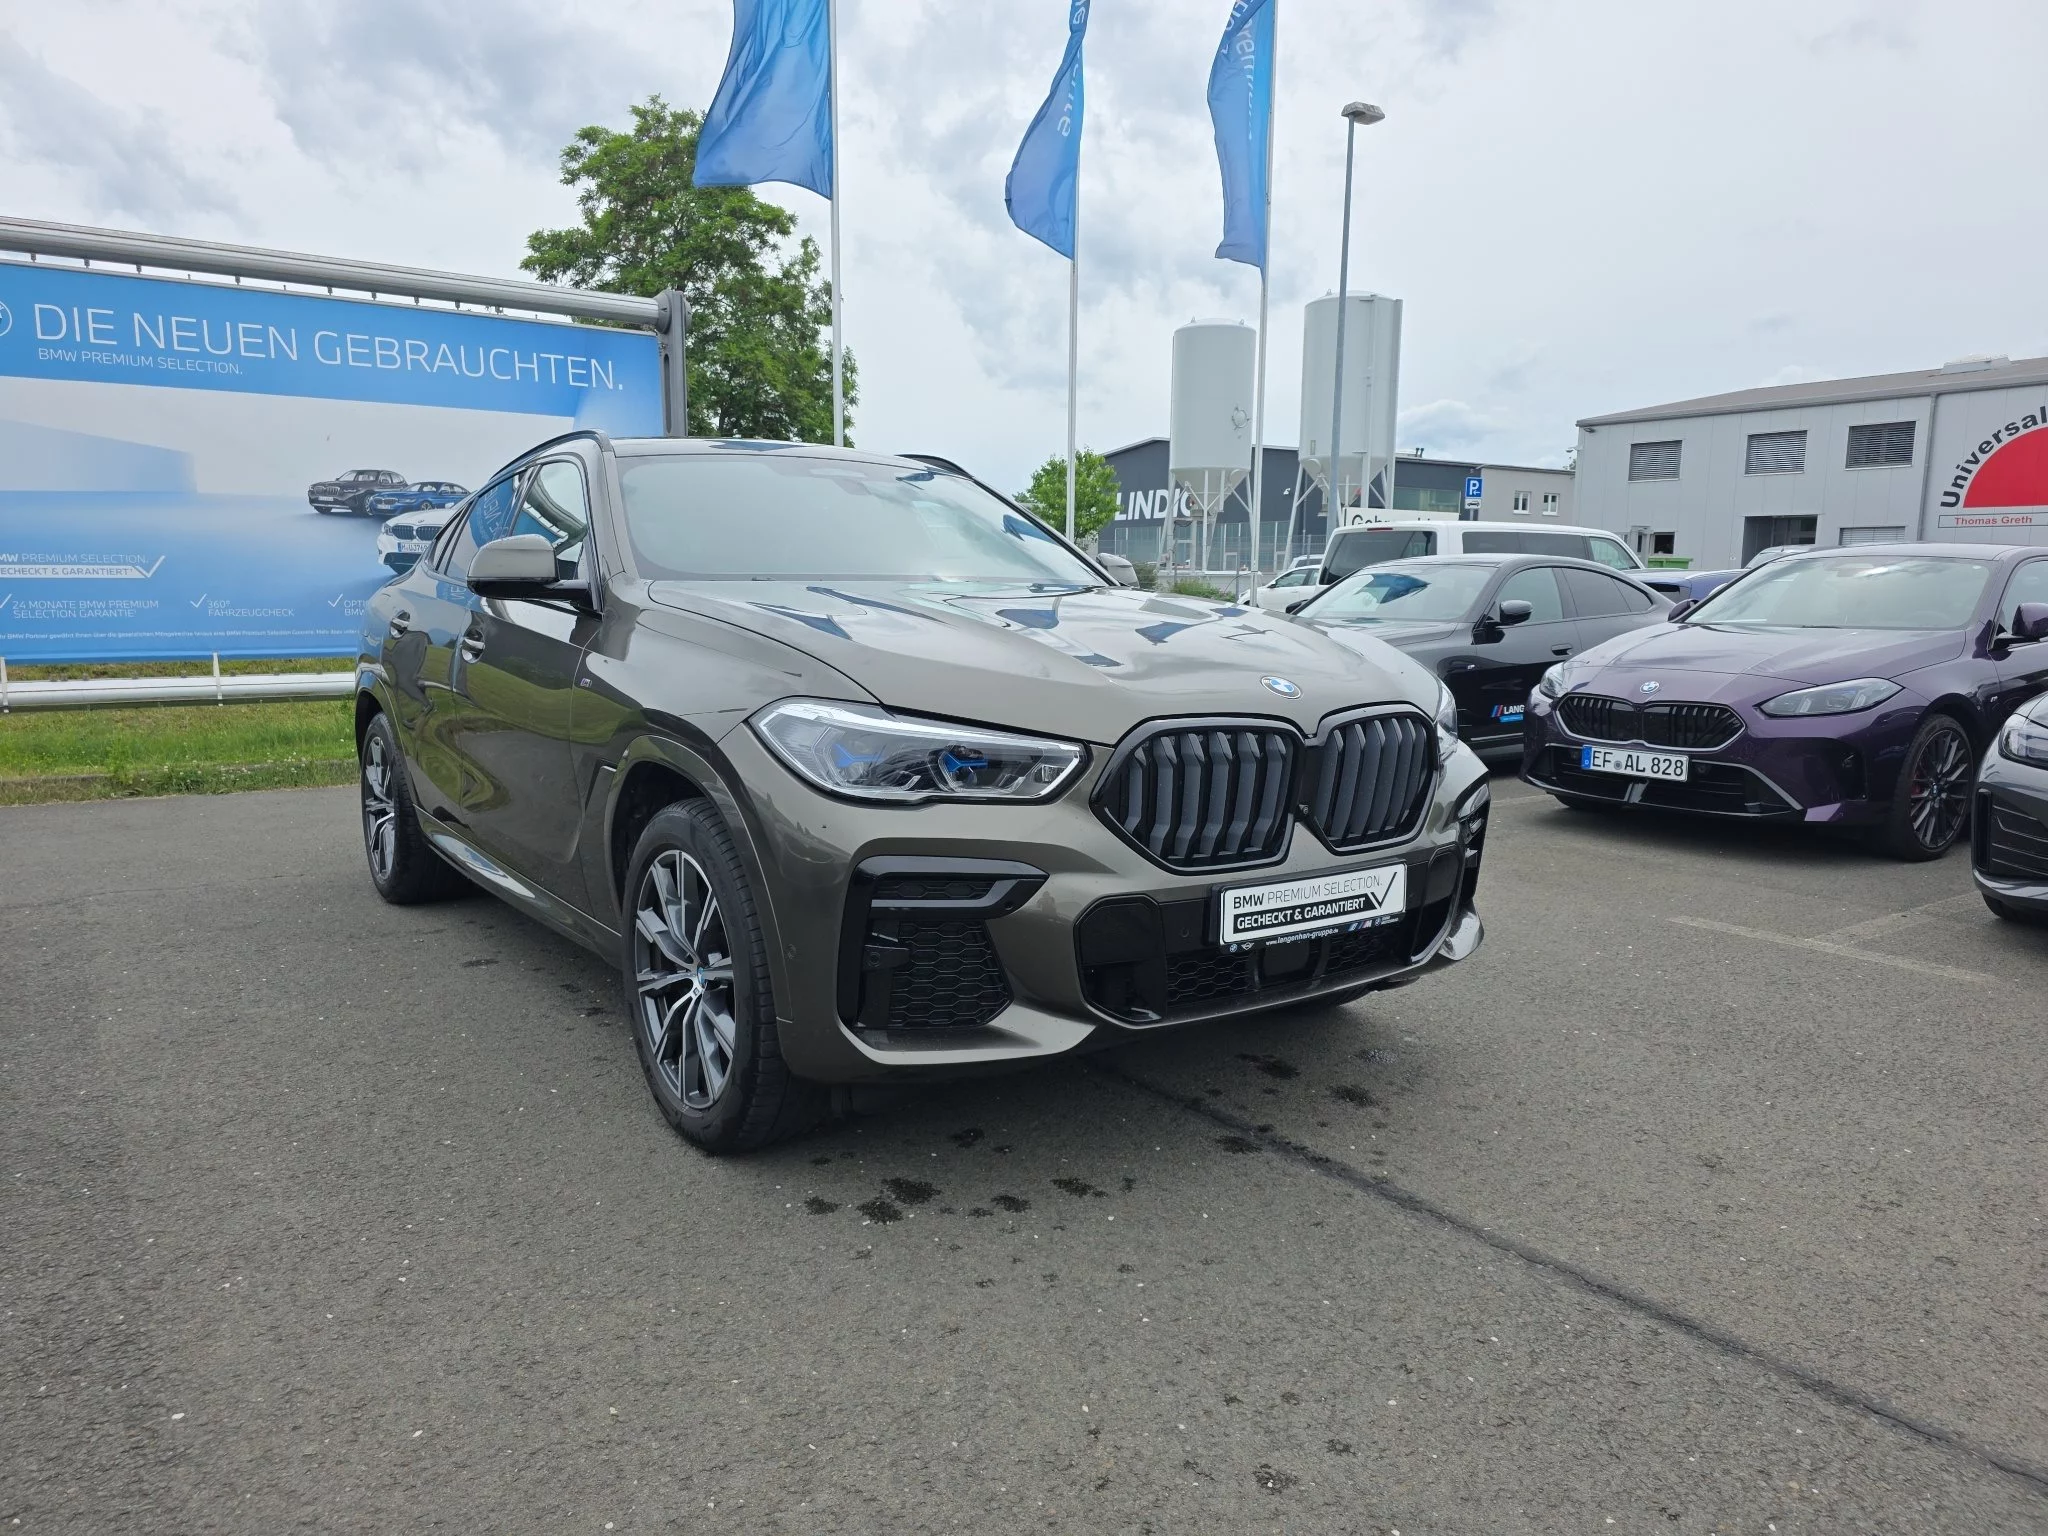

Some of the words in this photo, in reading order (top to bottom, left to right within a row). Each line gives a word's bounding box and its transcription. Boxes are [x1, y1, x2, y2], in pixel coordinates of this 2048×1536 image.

[34, 303, 118, 346] DIE
[133, 312, 298, 361] NEUEN
[313, 330, 624, 391] GEBRAUCHTEN.
[38, 348, 77, 363] BMW
[82, 350, 153, 369] PREMIUM
[158, 356, 243, 376] SELECTION.
[1470, 480, 1480, 495] P
[1954, 516, 1998, 526] Thomas
[2001, 515, 2033, 525] Greth
[22, 553, 78, 563] PREMIUM
[0, 567, 48, 576] ECHECKT
[52, 567, 59, 576] &
[12, 600, 26, 609] 24
[29, 600, 76, 609] MONATE
[79, 600, 107, 609] BMW
[109, 600, 159, 609] PREMIUM
[13, 609, 77, 619] SELECTION
[1592, 750, 1613, 768] EF
[1624, 754, 1646, 773] AL
[1650, 757, 1684, 777] 828
[1233, 892, 1265, 910] BMW
[1267, 884, 1321, 905] PREMIUM
[1324, 875, 1383, 896] SELECTION.
[1237, 909, 1293, 930] GECHECKT
[1294, 908, 1303, 921] &
[1304, 897, 1366, 919] GARANTIERT
